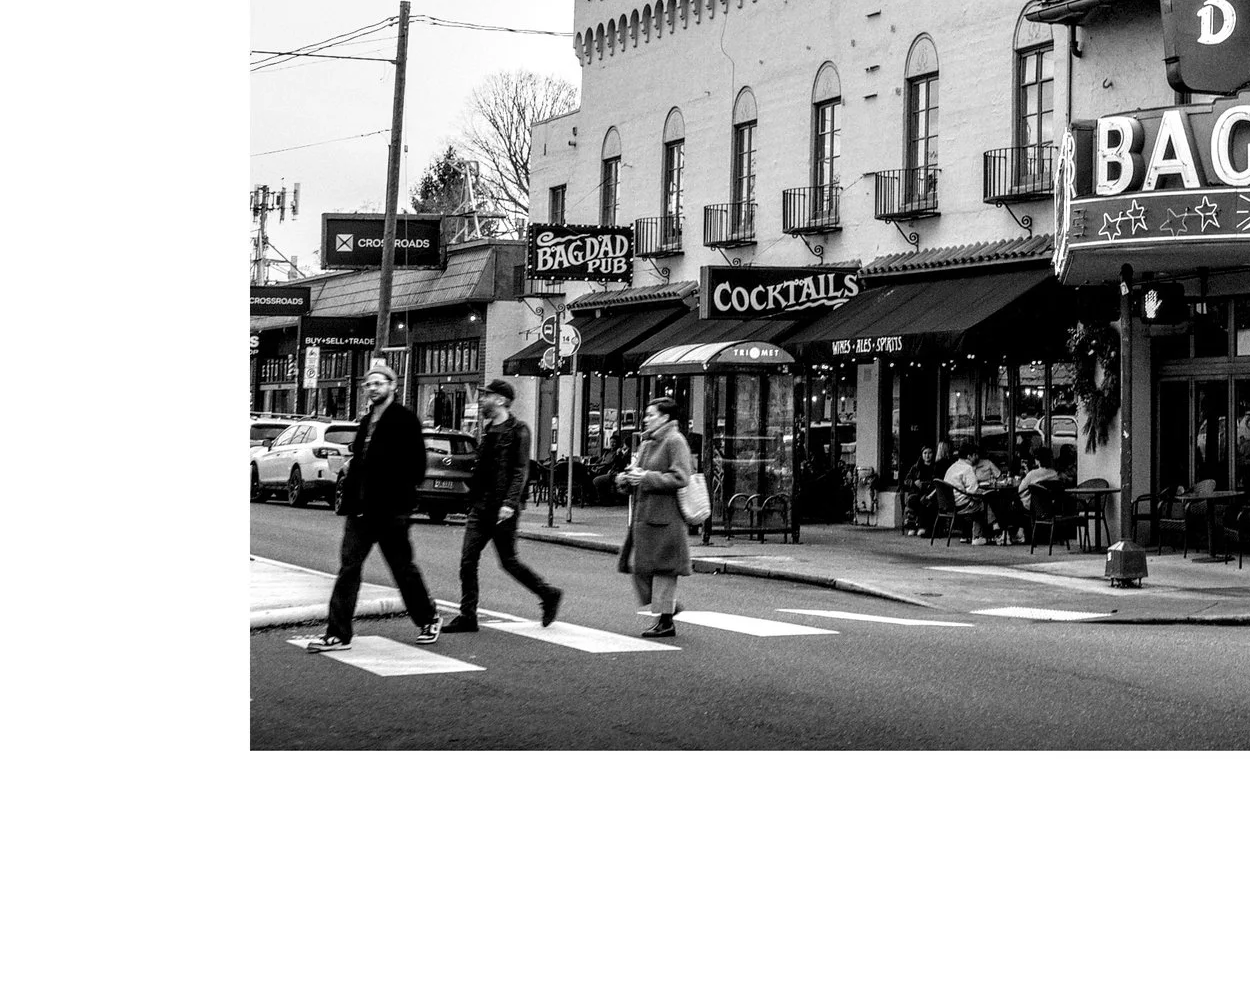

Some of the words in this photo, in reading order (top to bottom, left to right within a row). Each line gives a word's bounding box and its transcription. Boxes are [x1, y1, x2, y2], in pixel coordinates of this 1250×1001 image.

[536, 234, 629, 271] BAGDAD
[587, 257, 628, 274] PUB
[250, 297, 304, 305] CROSSROADS
[713, 273, 859, 312] COCKTAILS
[855, 338, 872, 353] ALES
[876, 336, 903, 353] SPIRITS
